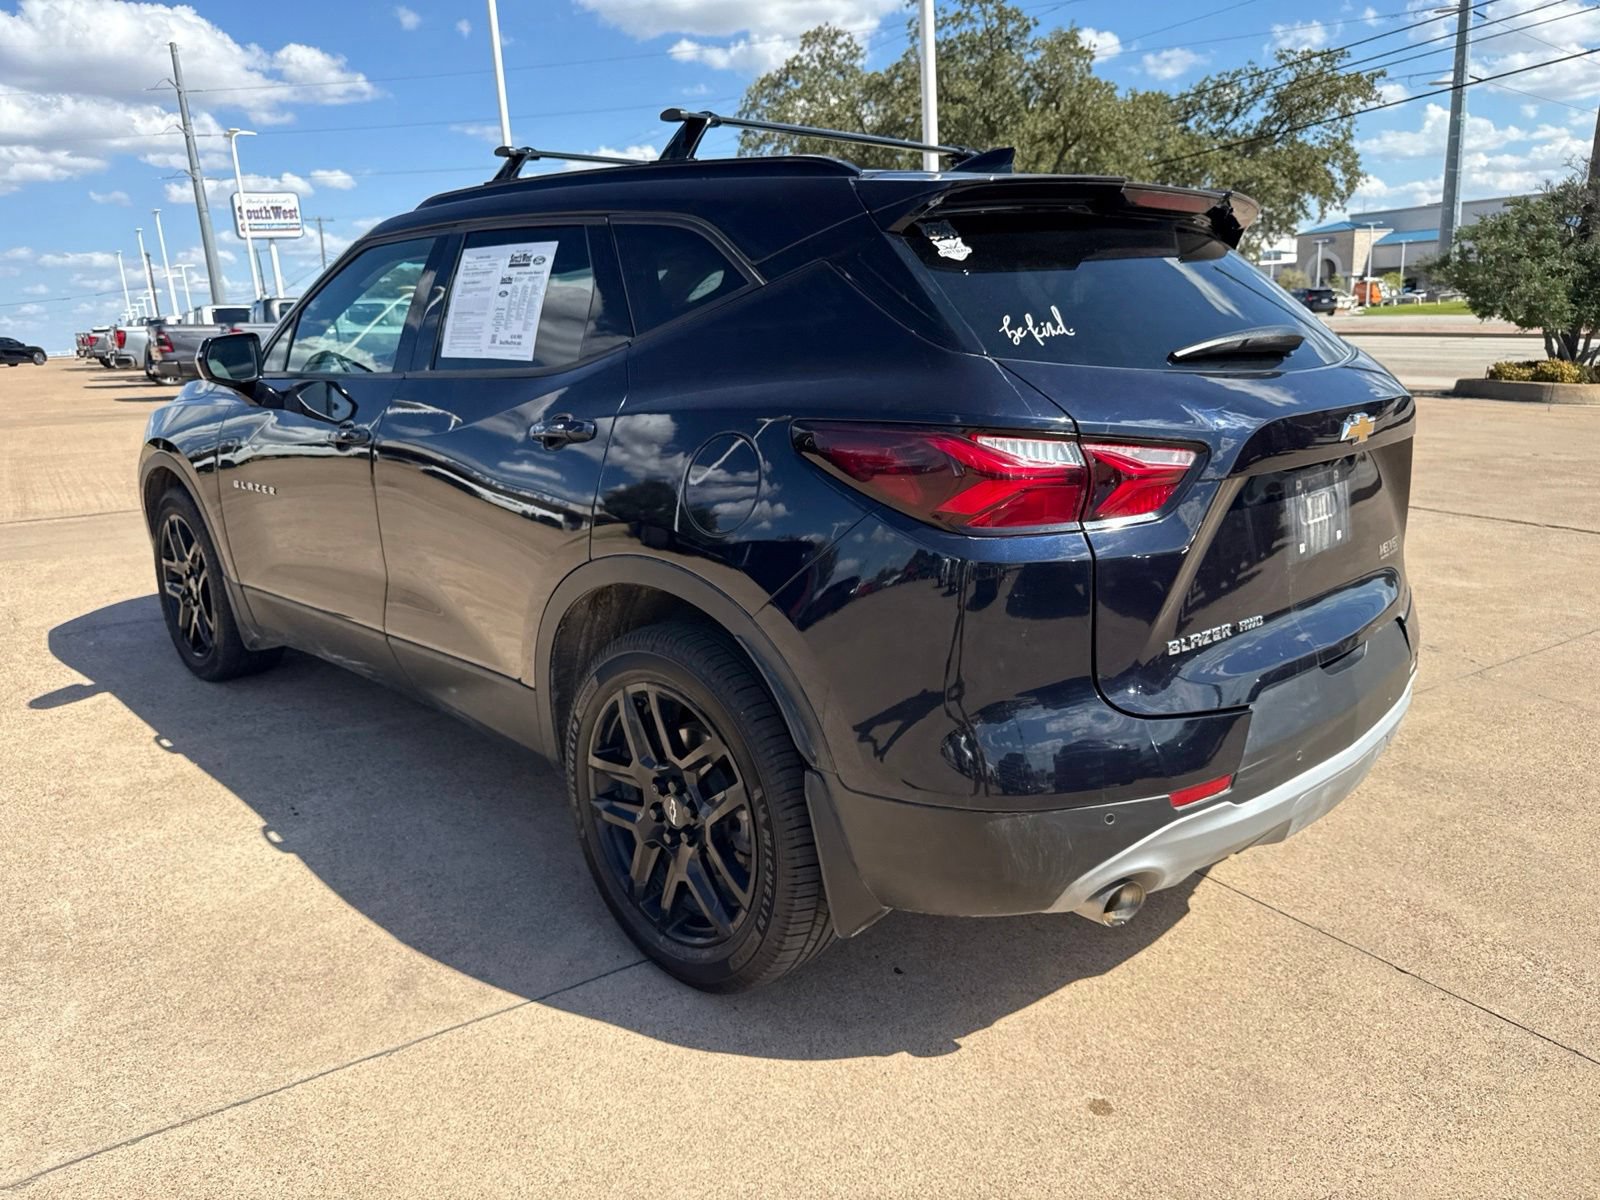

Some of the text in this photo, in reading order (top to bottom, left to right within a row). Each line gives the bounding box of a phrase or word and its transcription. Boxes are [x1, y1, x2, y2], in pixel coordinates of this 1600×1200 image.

[999, 315, 1027, 345] be
[233, 480, 276, 496] BLAZER
[1167, 623, 1232, 656] BLAZER
[756, 827, 774, 931] MICHELIN
